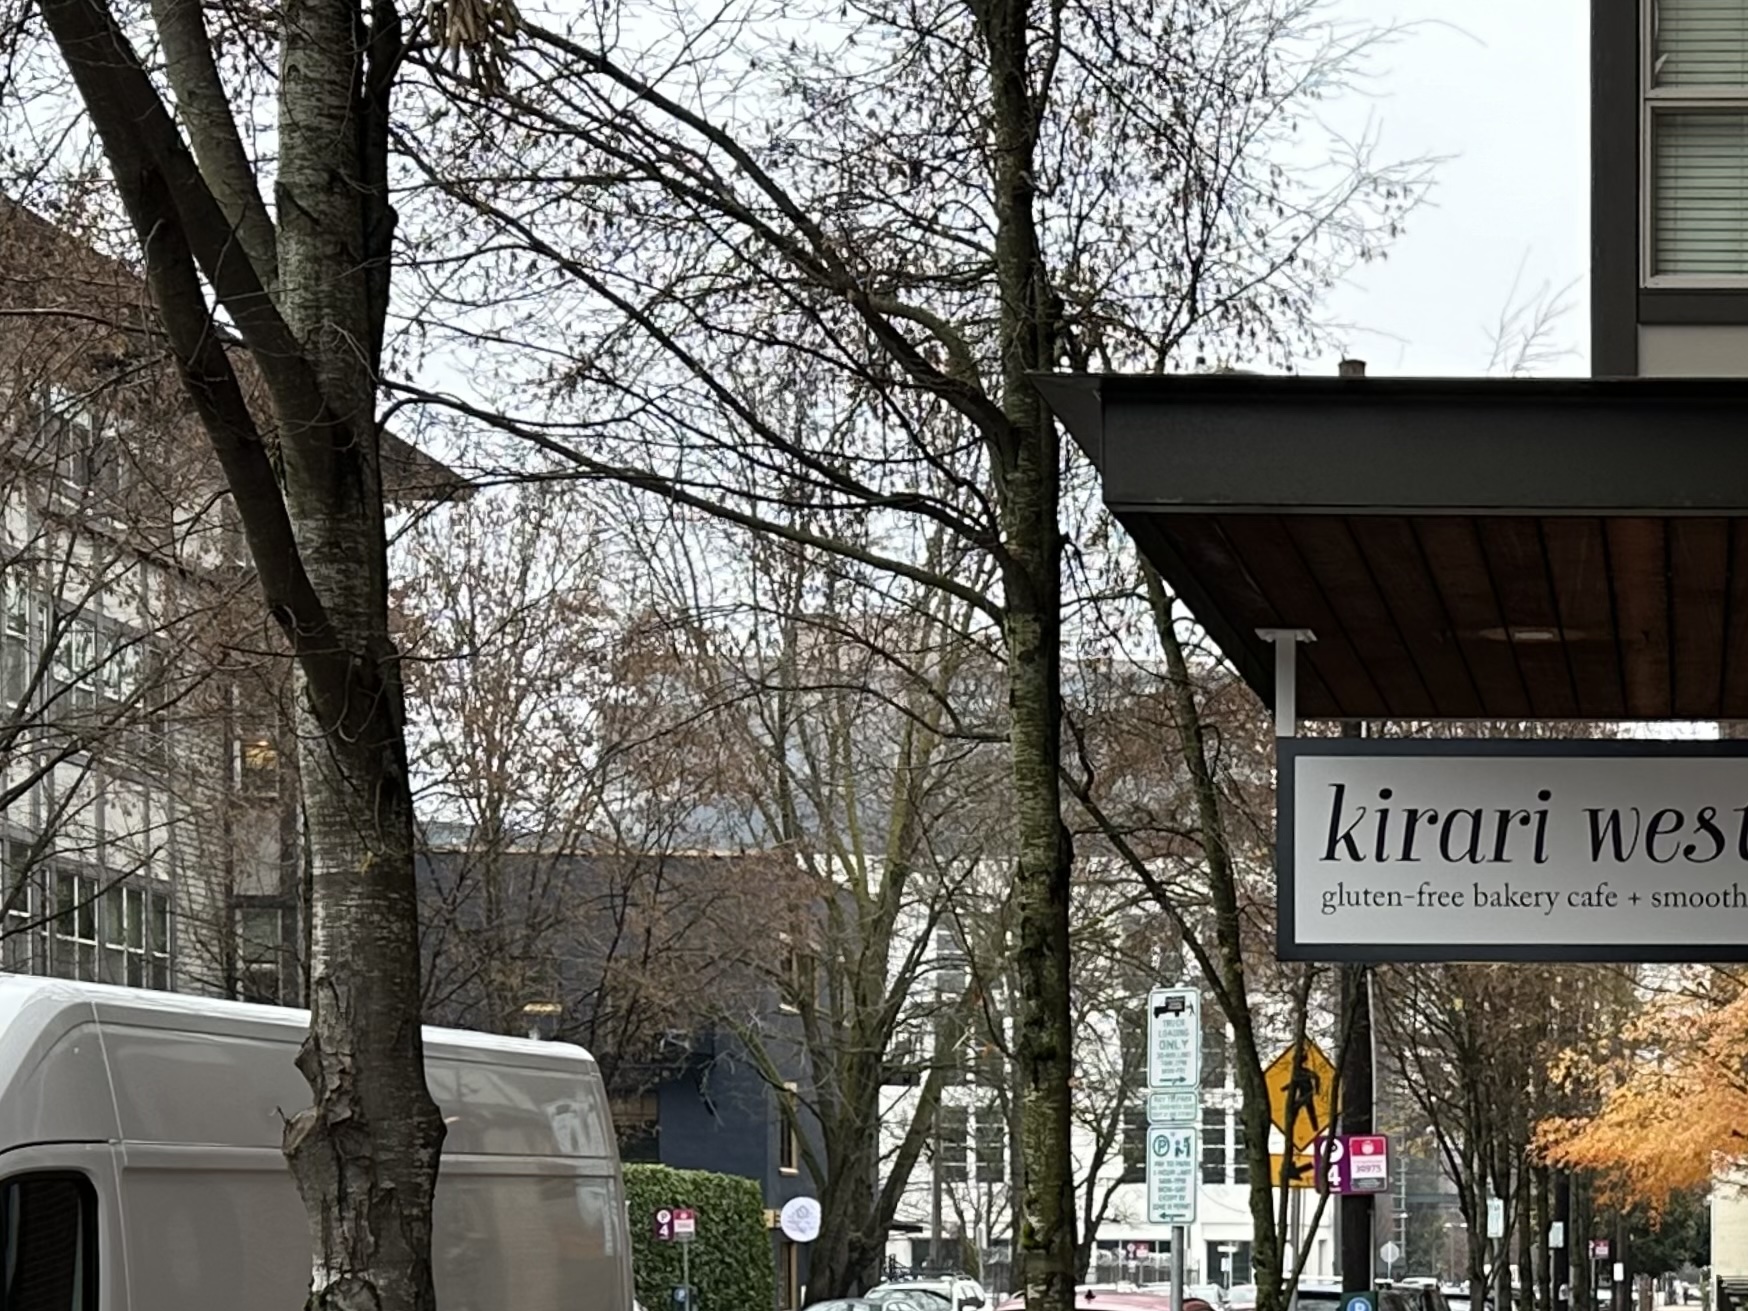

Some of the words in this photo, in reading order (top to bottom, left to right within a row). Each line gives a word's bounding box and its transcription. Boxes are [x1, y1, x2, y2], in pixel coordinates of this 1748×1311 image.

[1318, 783, 1552, 865] kirari
[1321, 881, 1465, 916] gluten-free
[1473, 881, 1560, 916] bakery
[1567, 881, 1618, 908] cafe
[1158, 1040, 1189, 1050] ONLY
[1328, 1165, 1342, 1186] 4
